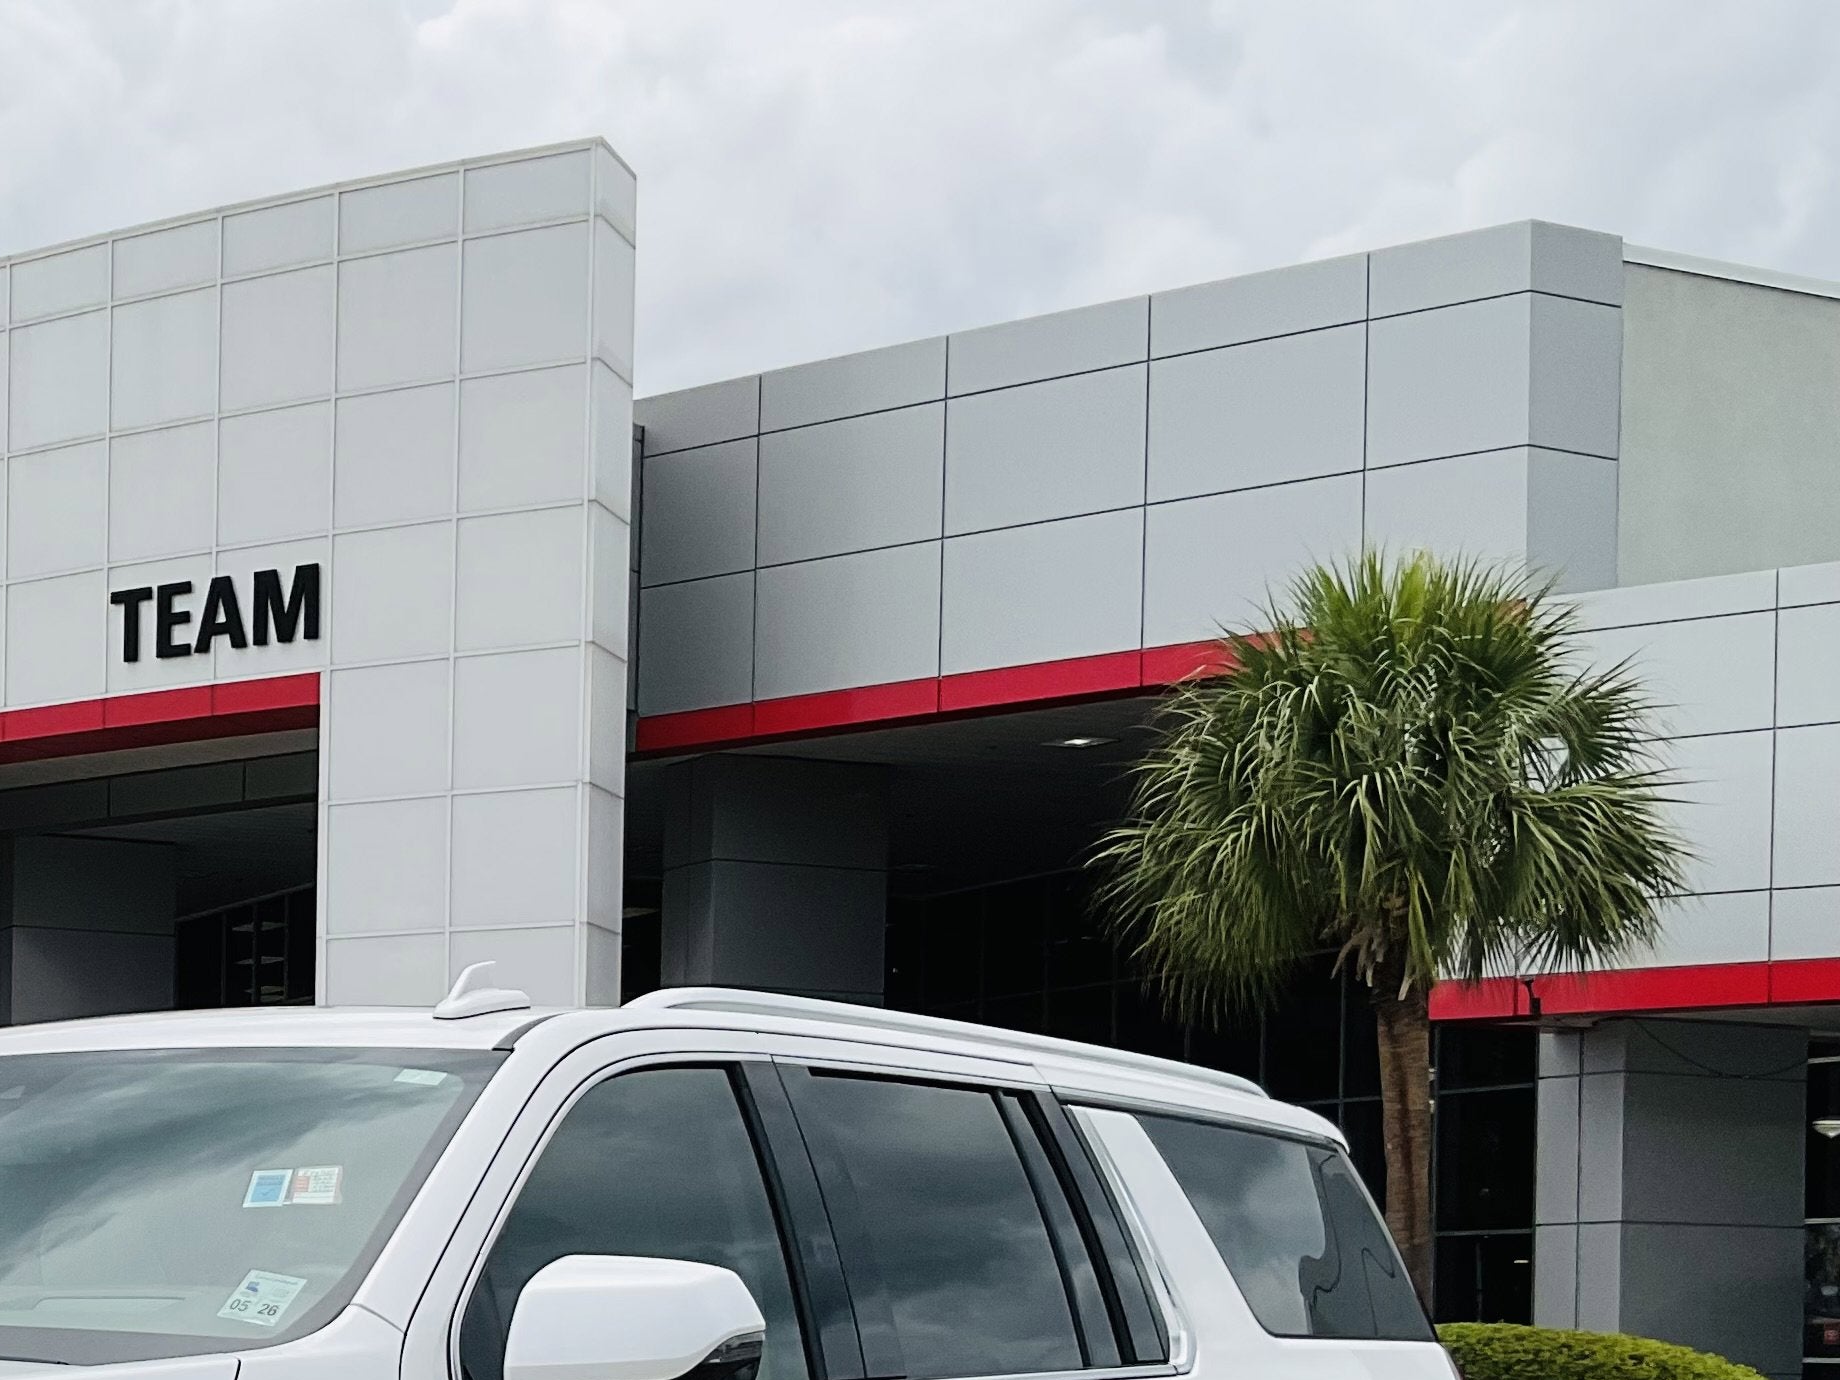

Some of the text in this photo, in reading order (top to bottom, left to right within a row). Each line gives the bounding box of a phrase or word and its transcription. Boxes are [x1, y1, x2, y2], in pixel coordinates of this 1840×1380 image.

[110, 563, 319, 662] TEAM
[229, 1298, 280, 1317] 05 26
